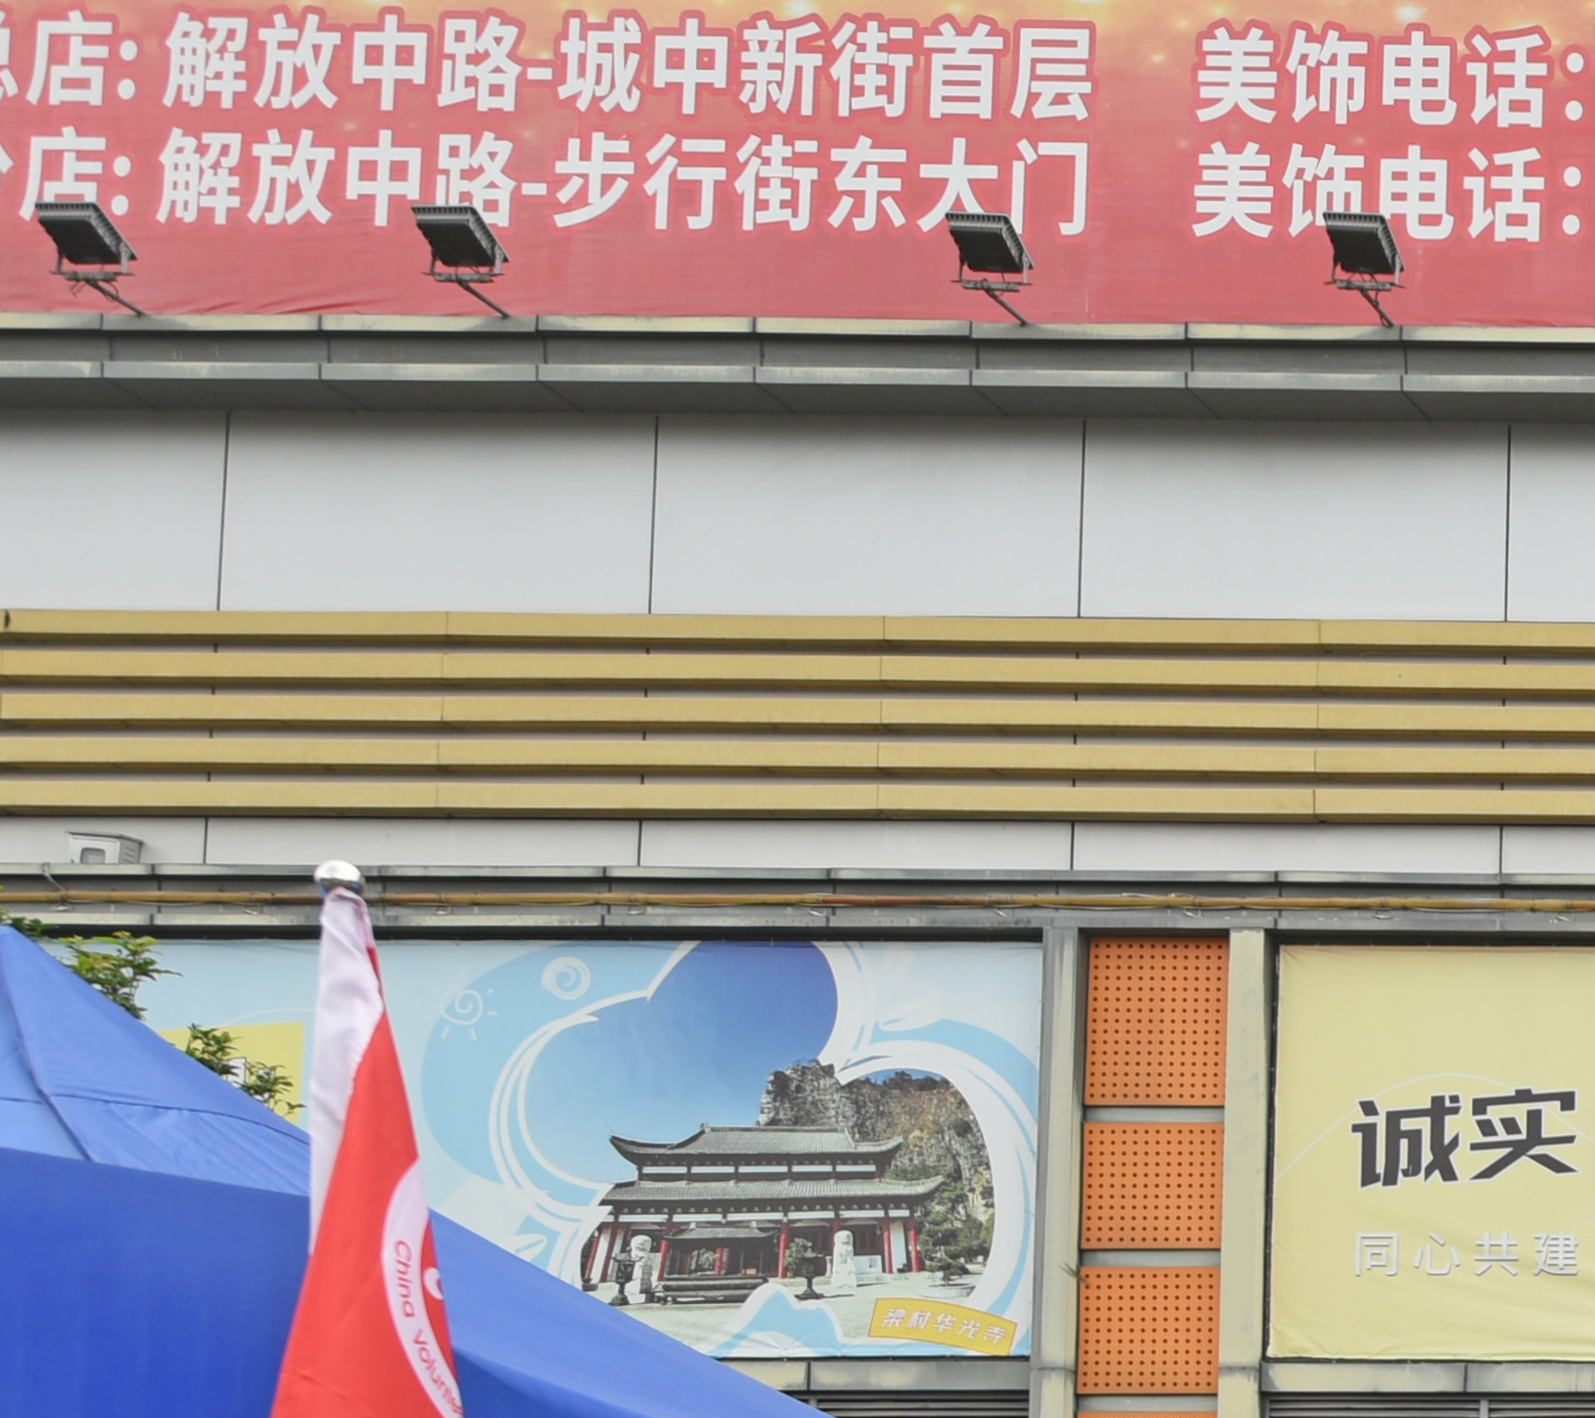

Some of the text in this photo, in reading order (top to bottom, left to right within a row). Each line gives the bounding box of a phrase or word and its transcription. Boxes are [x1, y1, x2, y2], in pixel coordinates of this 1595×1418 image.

[0, 12, 1092, 121] 店:解放中路-城中新街首层
[0, 125, 1090, 236] 店:解放中路-步行街东大门
[1350, 1087, 1582, 1190] 诚实
[1354, 1231, 1580, 1278] 同心共建
